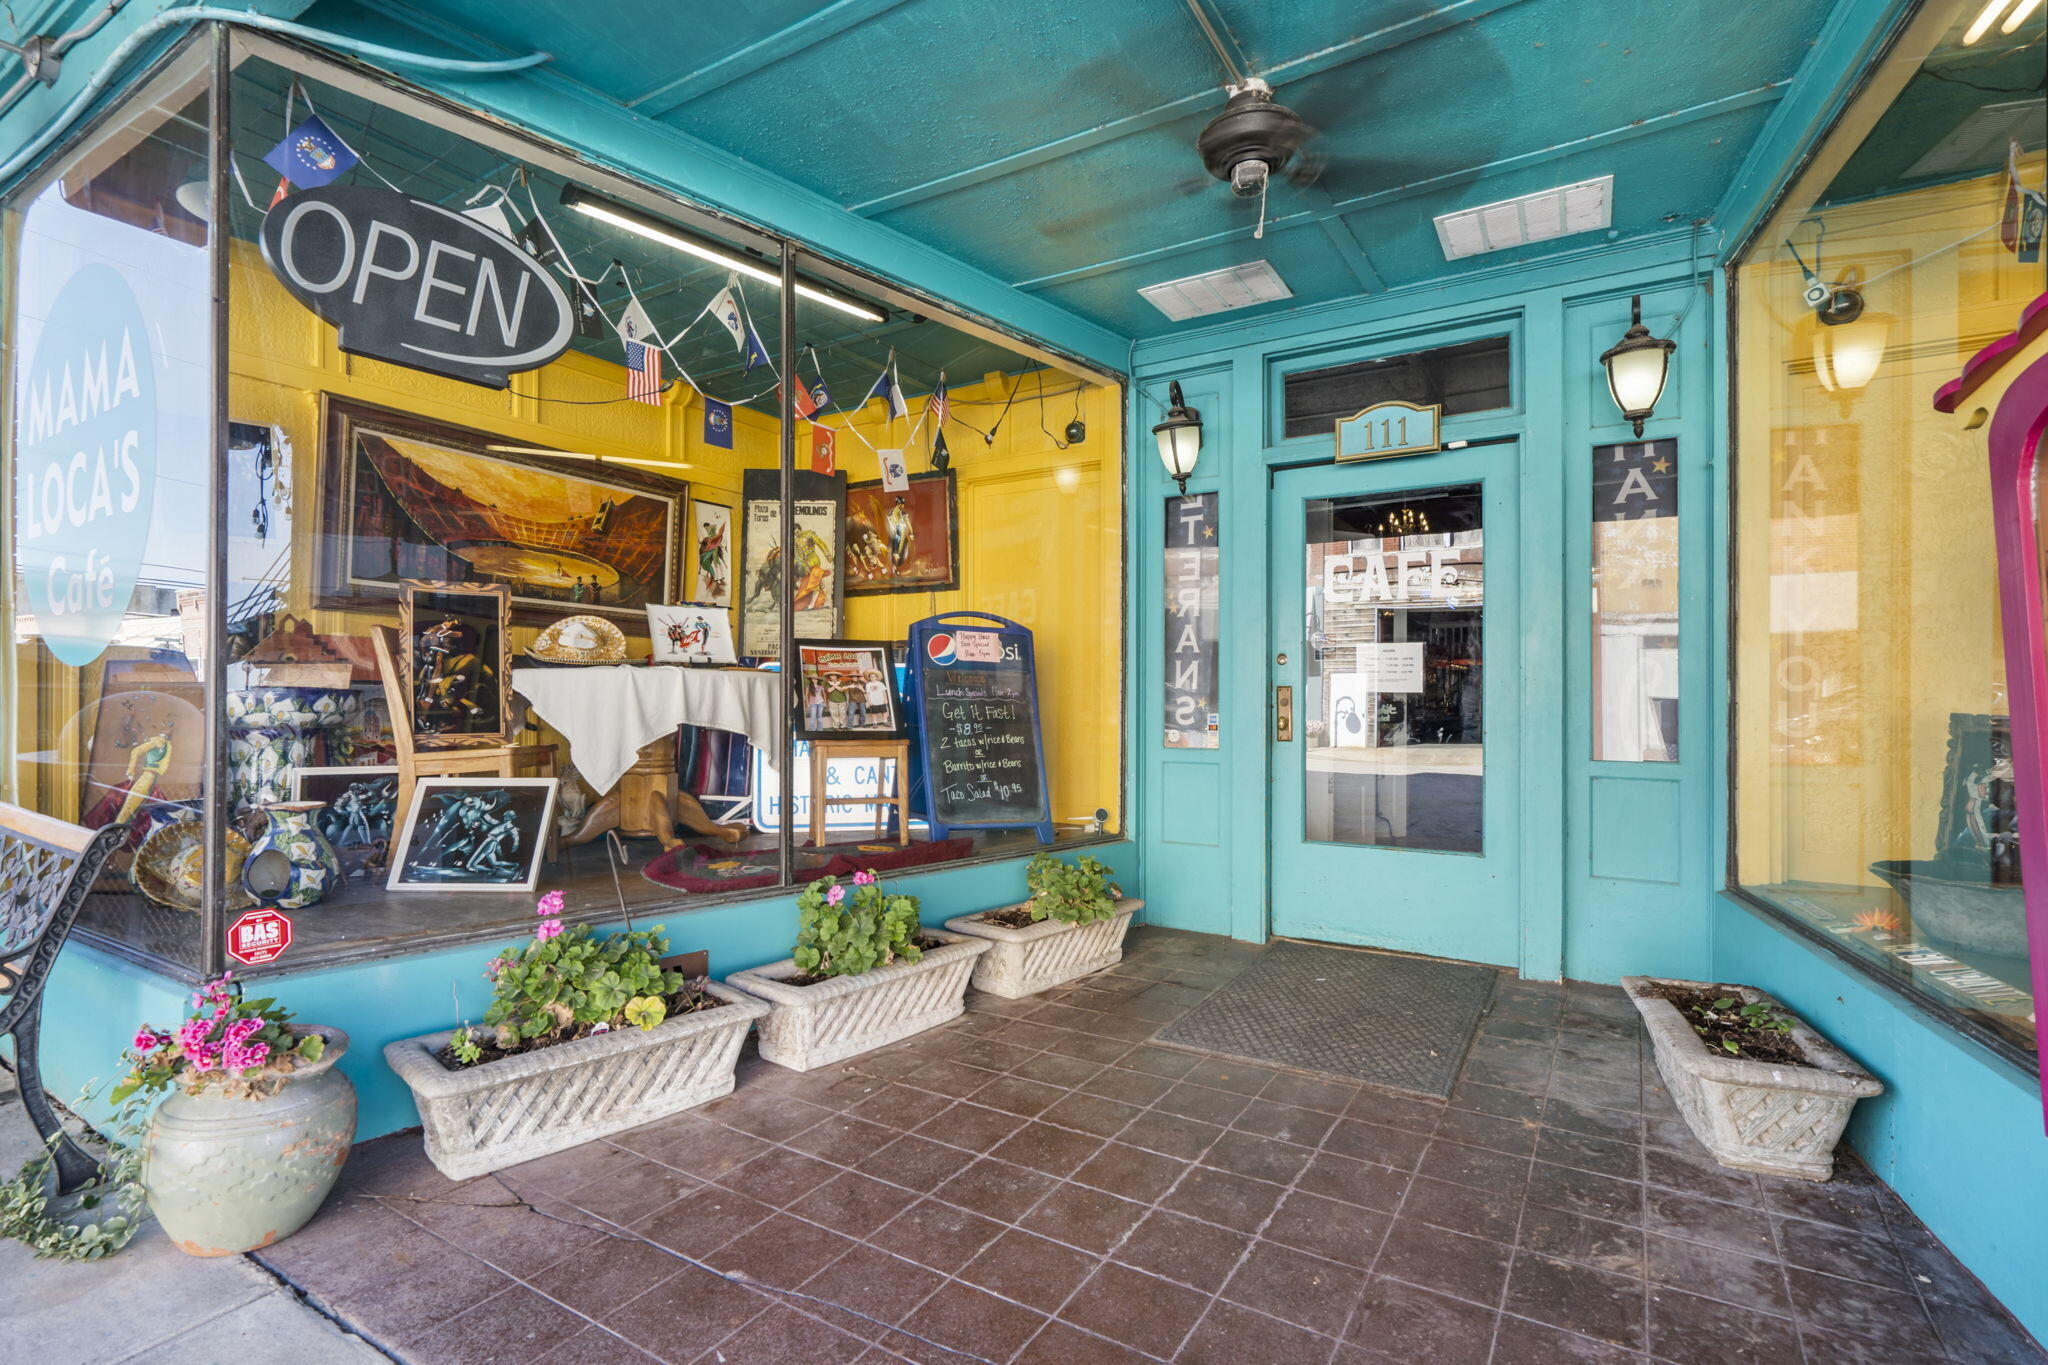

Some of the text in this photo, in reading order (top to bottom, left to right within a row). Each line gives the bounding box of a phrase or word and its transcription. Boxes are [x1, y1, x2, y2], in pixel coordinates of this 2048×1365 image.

[281, 200, 531, 348] OPEN
[28, 324, 140, 447] MAMA
[1364, 416, 1409, 450] 111
[27, 429, 141, 540] LOCA'S
[754, 505, 769, 513] Plaza
[770, 510, 777, 518] de
[754, 514, 769, 522] Toros
[48, 548, 114, 616] Café
[1323, 549, 1462, 604] CAFE
[936, 684, 965, 697] Lunch
[942, 701, 1017, 721] Get it Fast!
[940, 736, 951, 749] 2
[953, 736, 977, 749] tacos
[826, 766, 842, 785] &
[942, 759, 975, 774] Burrito
[1002, 758, 1022, 768] Beans
[940, 783, 965, 805] Taco
[966, 782, 992, 802] Salad
[240, 922, 280, 943] BAS
[240, 937, 280, 949] SECURITY
